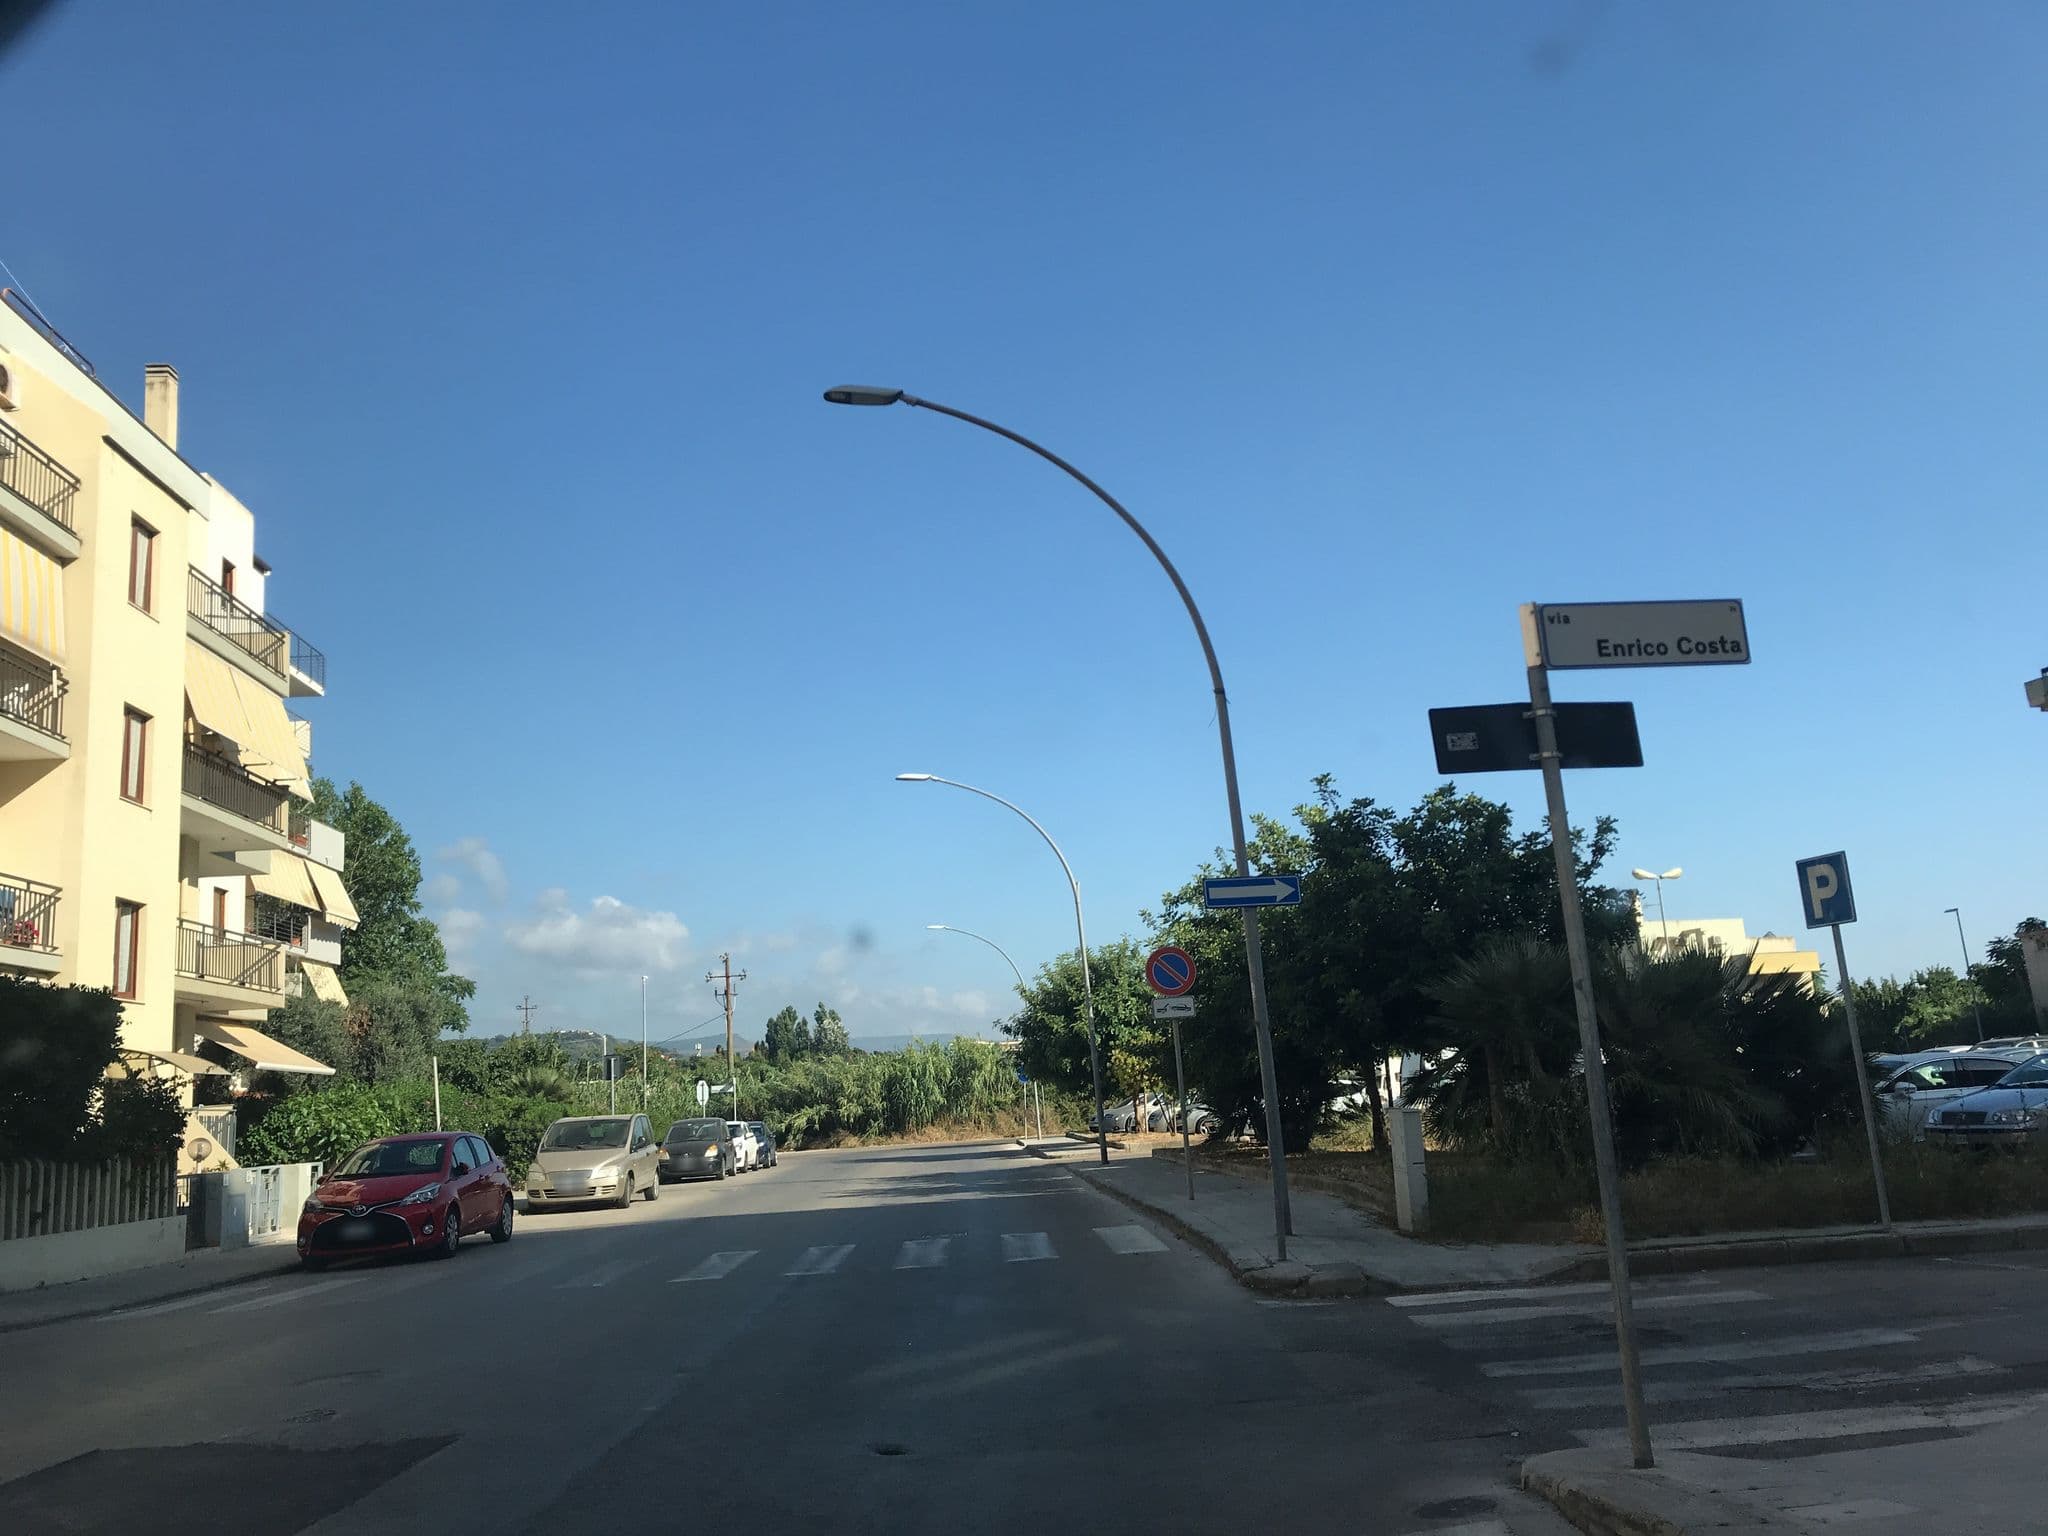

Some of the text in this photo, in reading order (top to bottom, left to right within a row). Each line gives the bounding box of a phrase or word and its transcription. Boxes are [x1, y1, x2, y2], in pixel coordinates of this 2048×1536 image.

[1547, 612, 1571, 625] via
[1596, 635, 1743, 658] Enrico Costa
[1806, 863, 1838, 919] P
